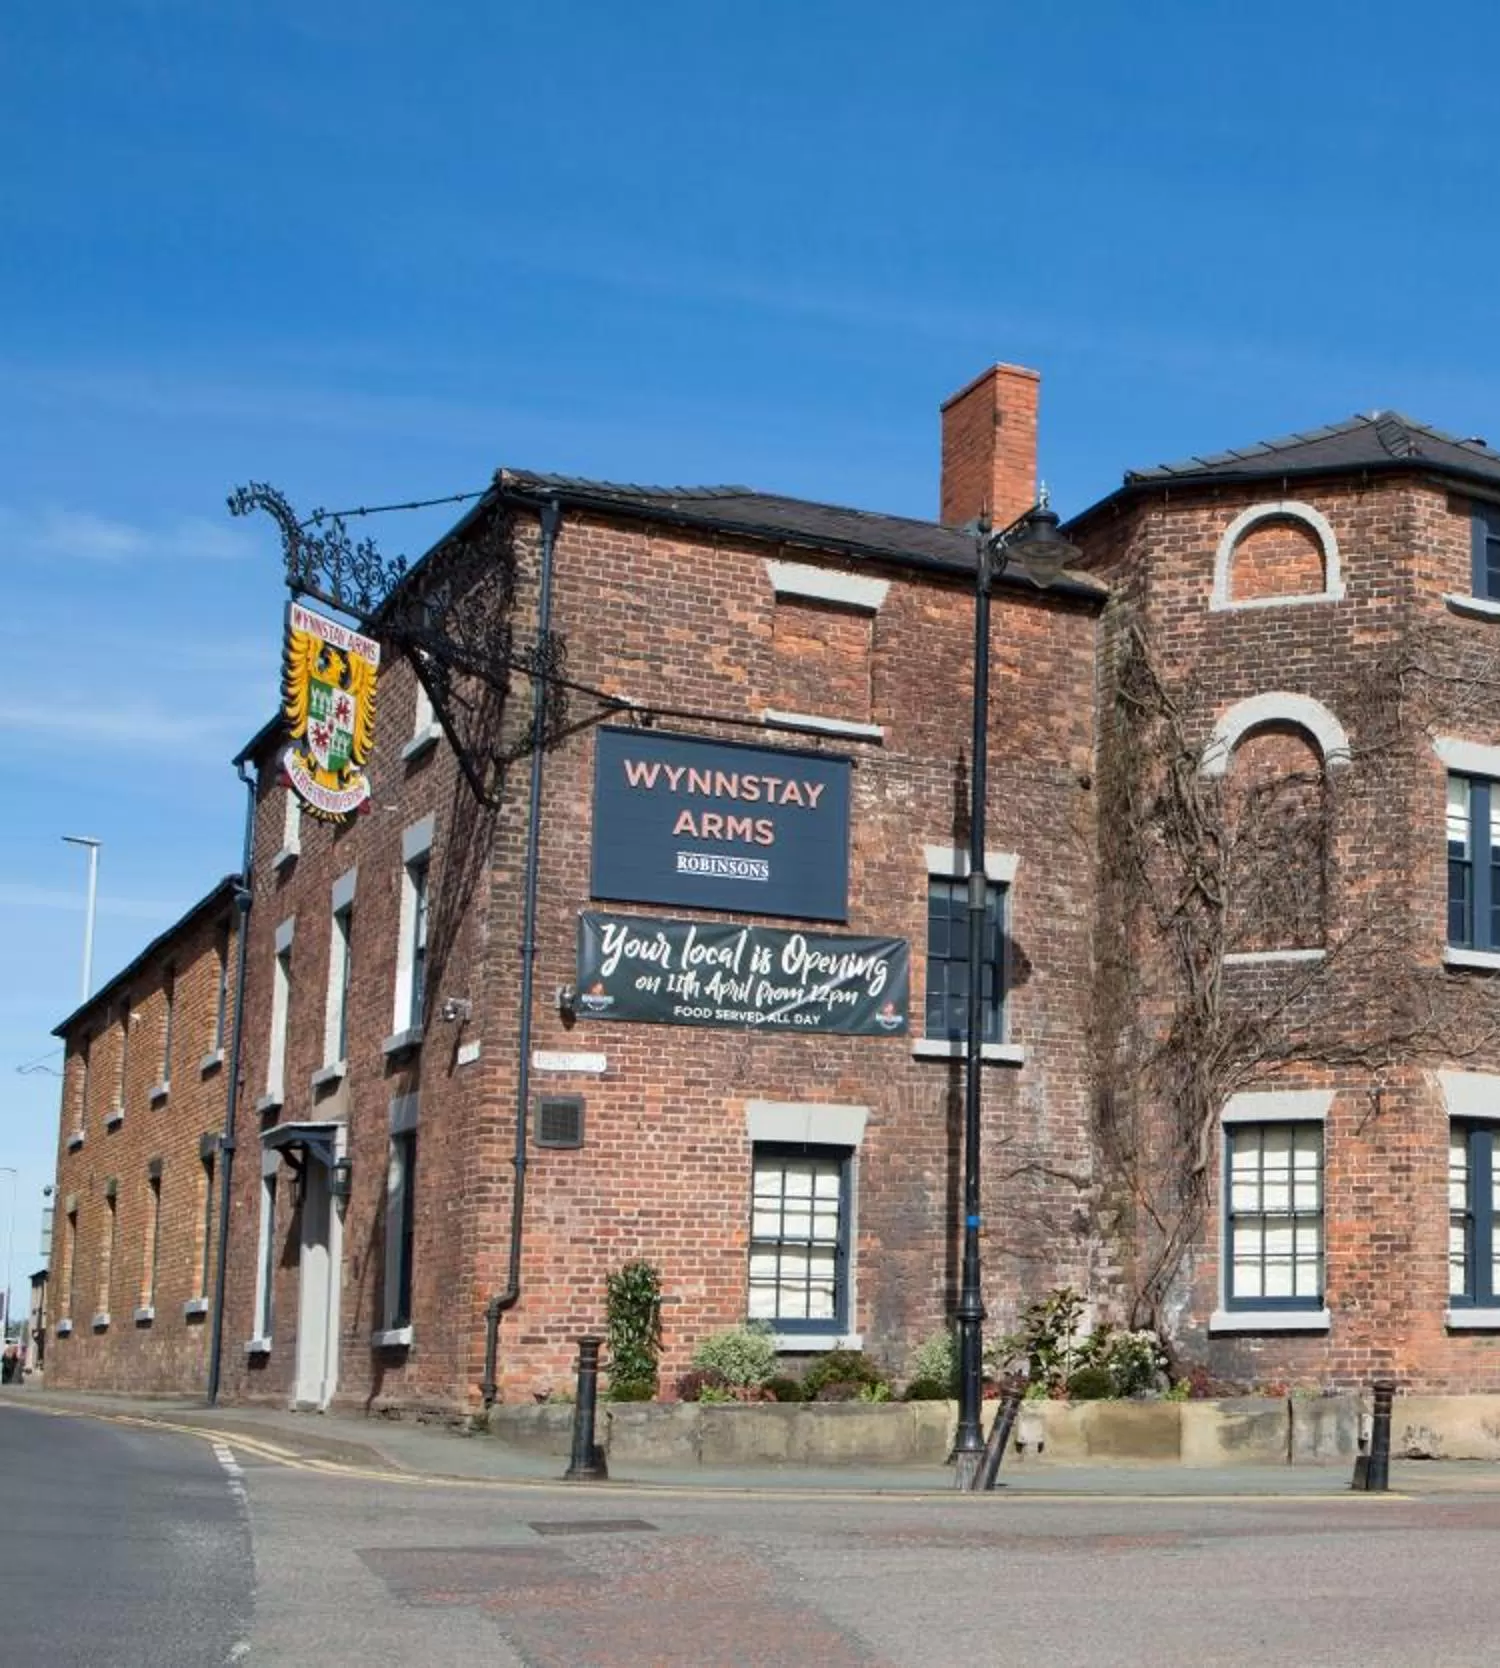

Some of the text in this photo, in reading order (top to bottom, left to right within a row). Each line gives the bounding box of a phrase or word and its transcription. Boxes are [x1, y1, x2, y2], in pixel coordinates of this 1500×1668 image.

[293, 606, 378, 662] WYNNSTAY ARMS
[624, 759, 826, 810] WYNNSTAY
[672, 809, 776, 846] ARMS
[676, 854, 769, 879] ROBINSONS
[600, 923, 889, 997] Your local is Opening
[635, 970, 859, 1012] on 11th April from 12pm
[673, 1005, 821, 1026] FOOD SERVED ALL DAY
